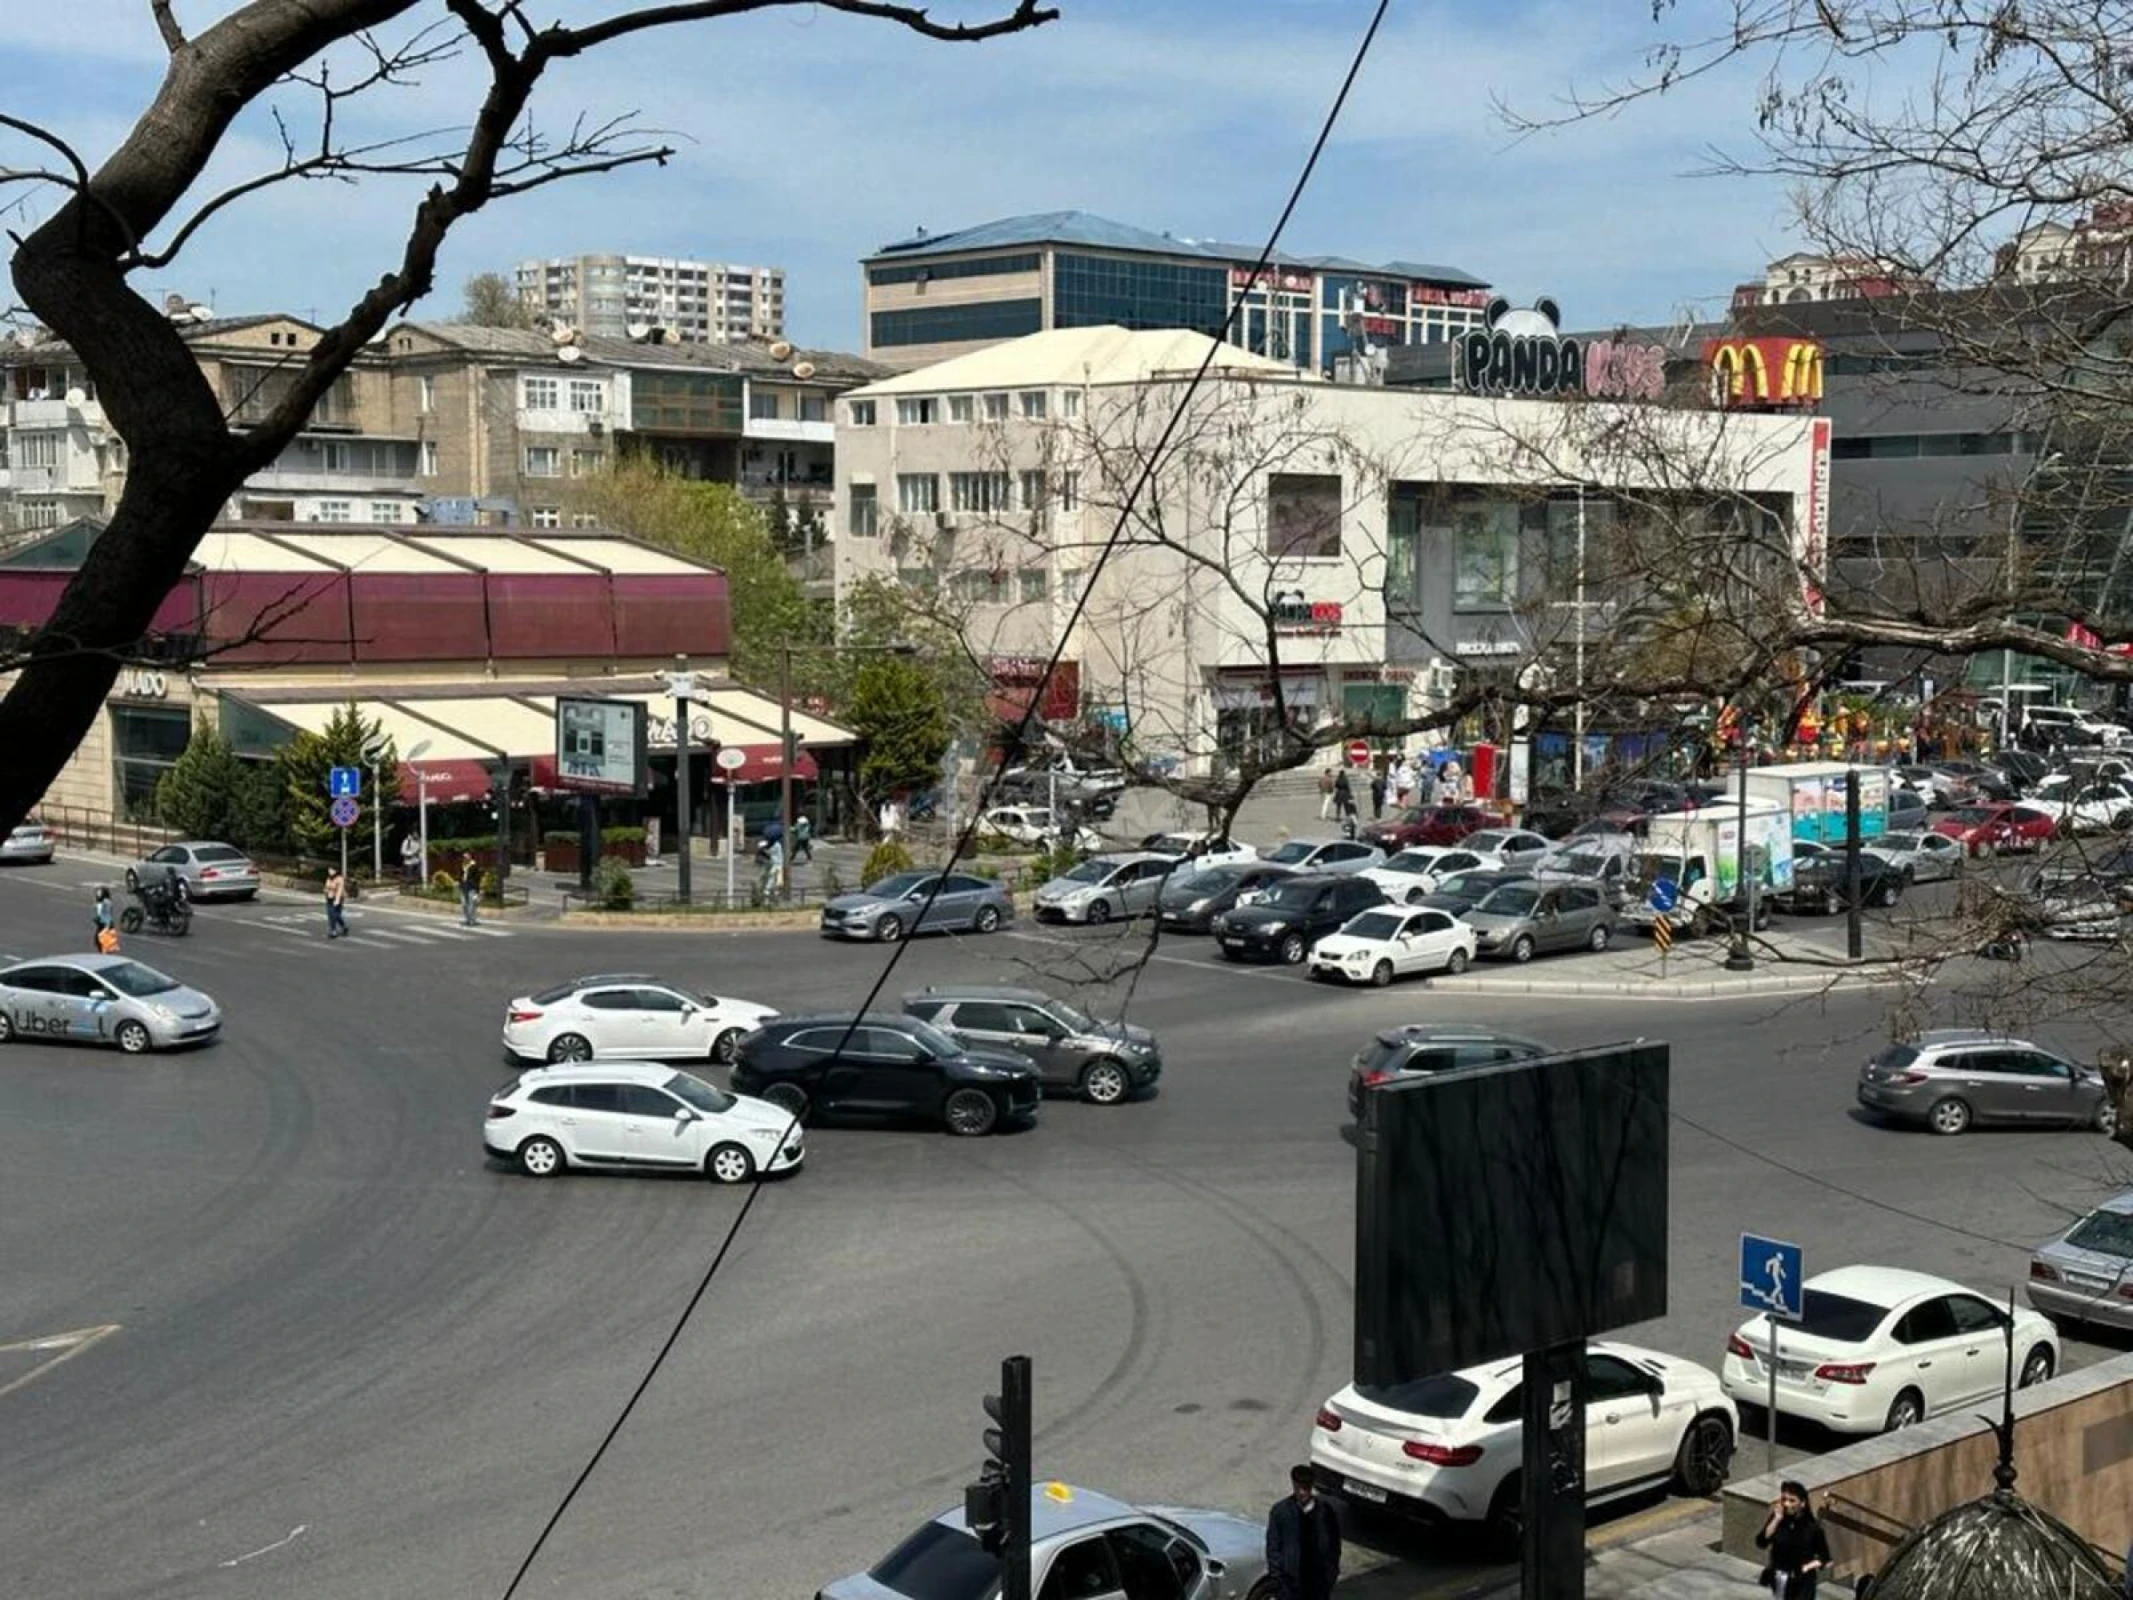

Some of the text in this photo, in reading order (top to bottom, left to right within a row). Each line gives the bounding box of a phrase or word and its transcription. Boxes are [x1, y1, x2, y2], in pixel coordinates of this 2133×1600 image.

[1465, 331, 1582, 394] PANDA
[648, 714, 713, 741] MAO
[14, 1009, 70, 1034] Uber
